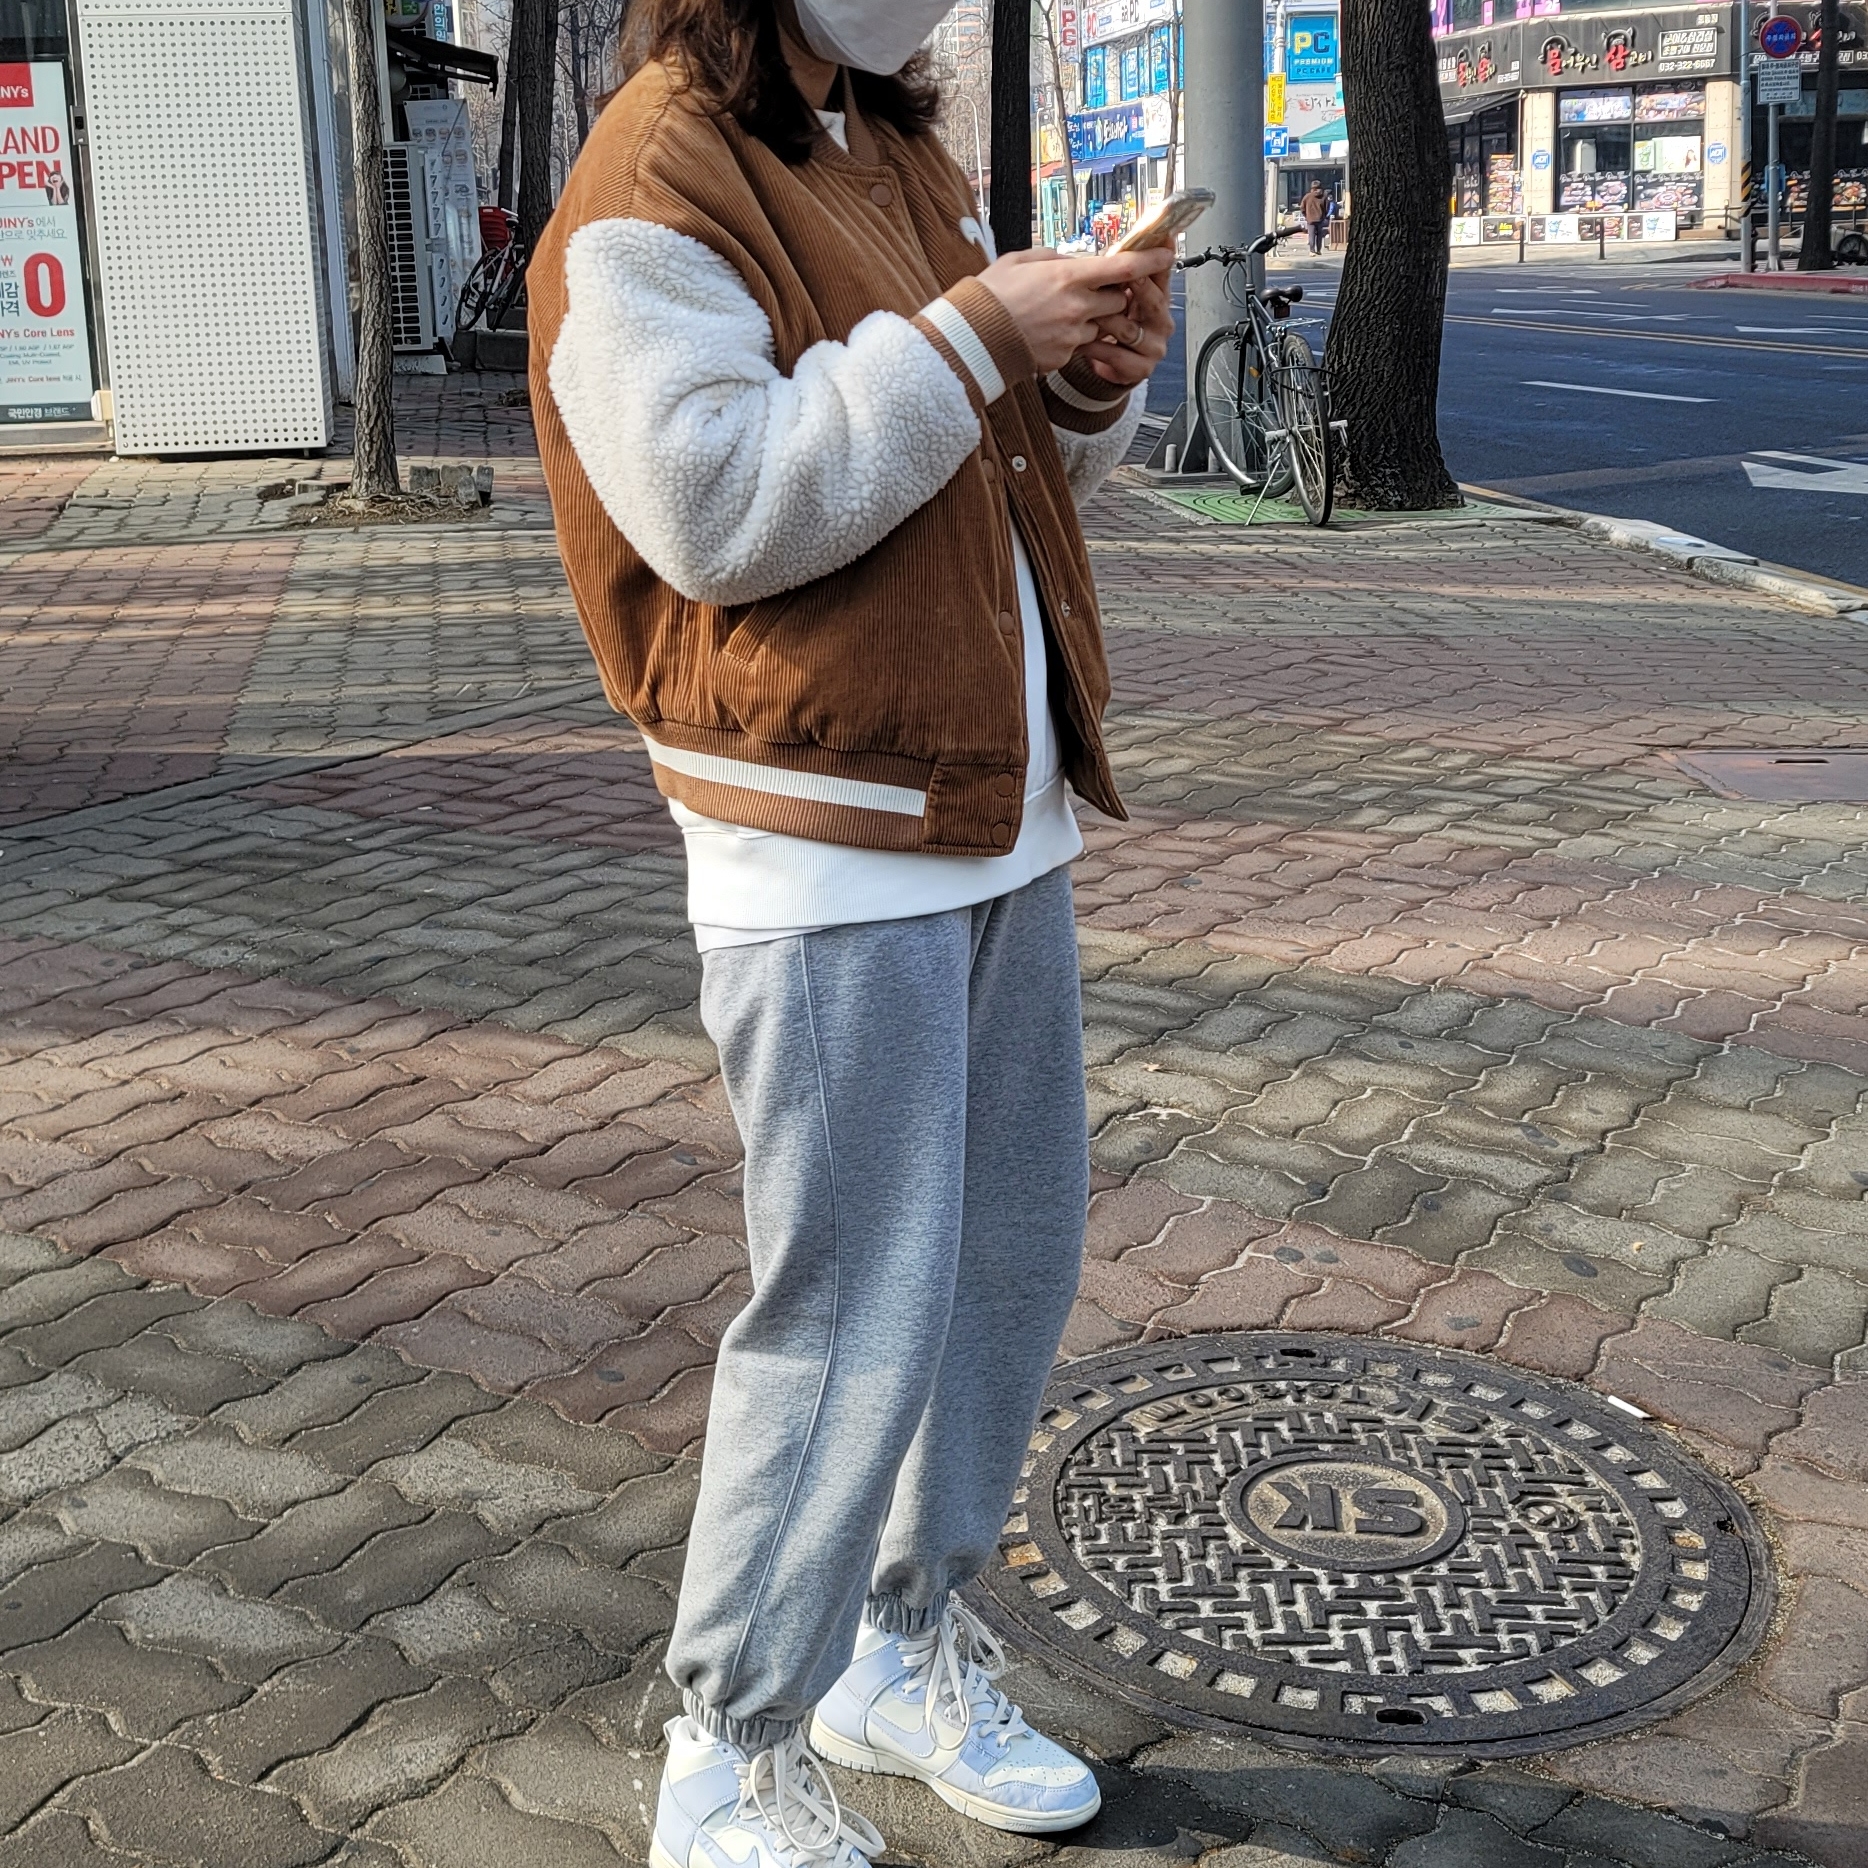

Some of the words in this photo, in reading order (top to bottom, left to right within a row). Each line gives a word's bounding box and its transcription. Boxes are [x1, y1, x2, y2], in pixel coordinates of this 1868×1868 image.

[1061, 10, 1077, 46] PC
[1294, 31, 1330, 55] PC
[0, 125, 60, 154] AND
[24, 252, 66, 317] 0
[24, 328, 47, 338] Core
[50, 327, 75, 337] Lens
[1267, 1482, 1424, 1535] SK
